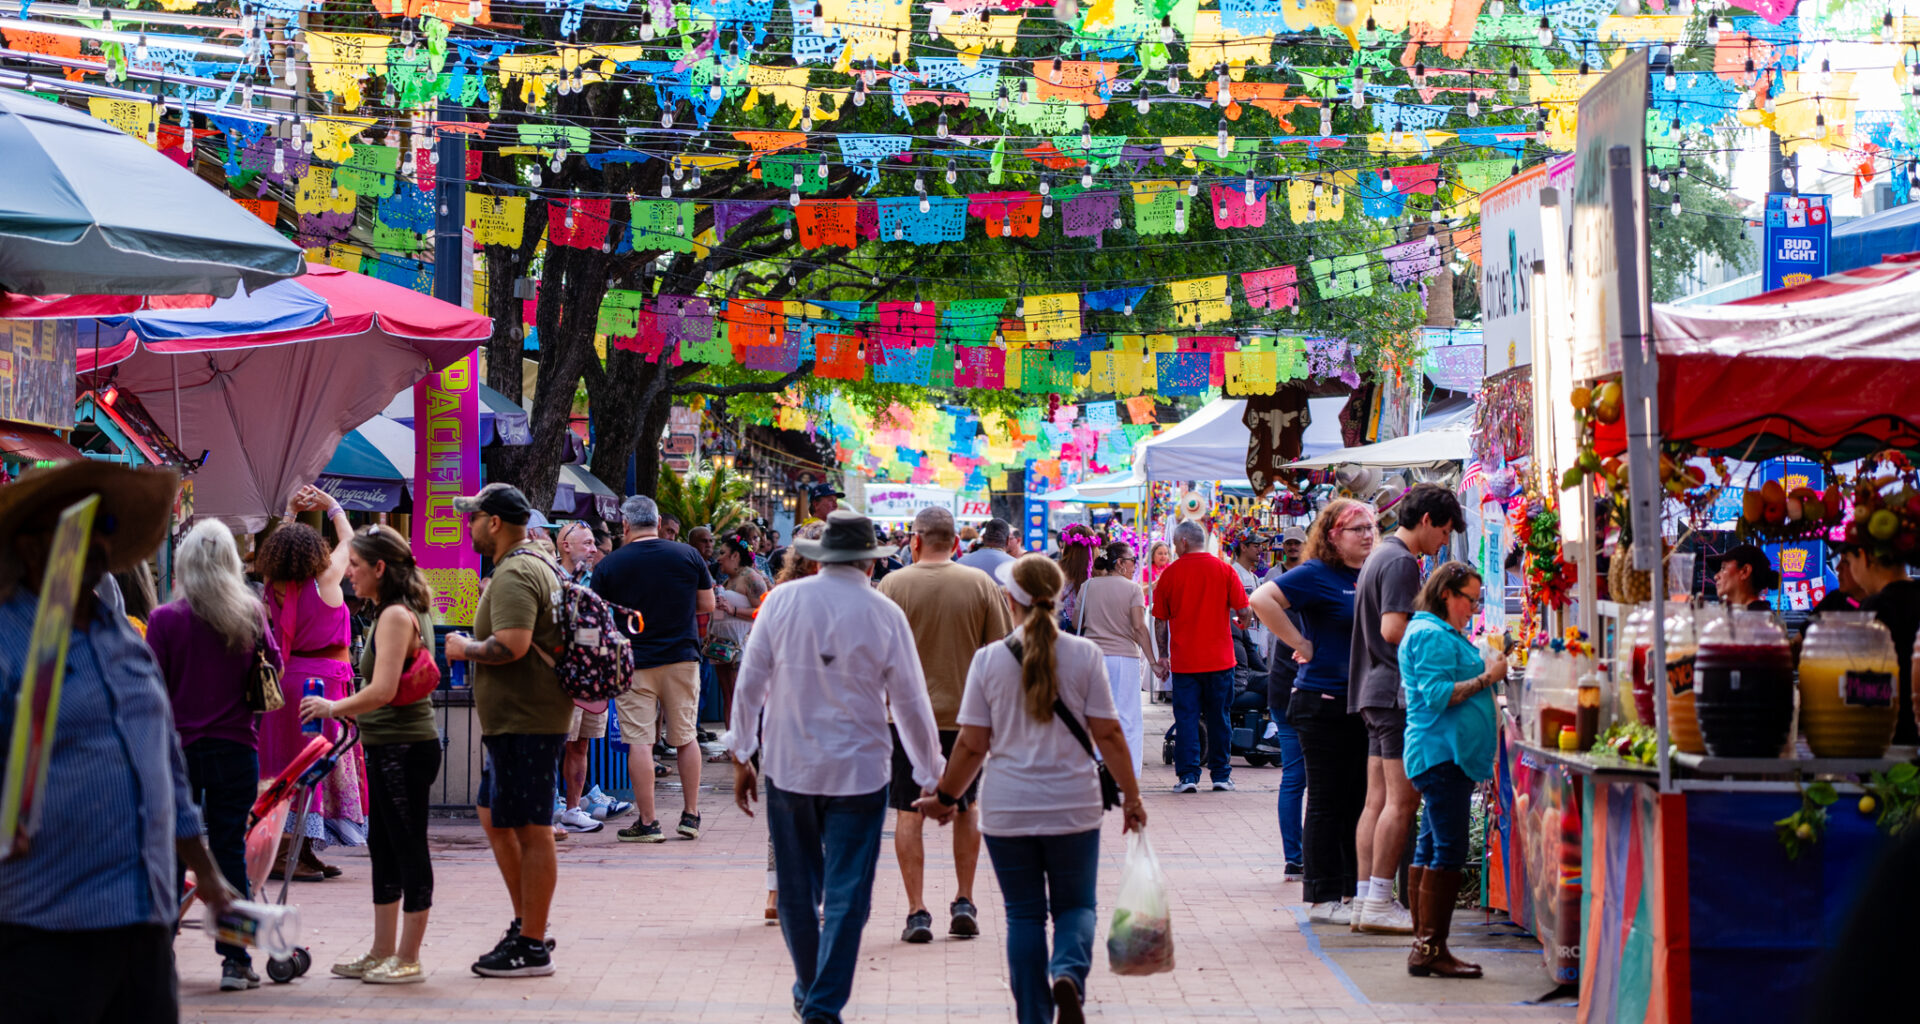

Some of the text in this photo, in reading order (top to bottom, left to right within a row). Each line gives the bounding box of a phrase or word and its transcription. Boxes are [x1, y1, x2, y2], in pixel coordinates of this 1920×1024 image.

[1778, 249, 1817, 261] LIGHT
[1783, 238, 1812, 250] BUD
[425, 356, 471, 548] PACIFICO
[321, 477, 387, 509] Margarita
